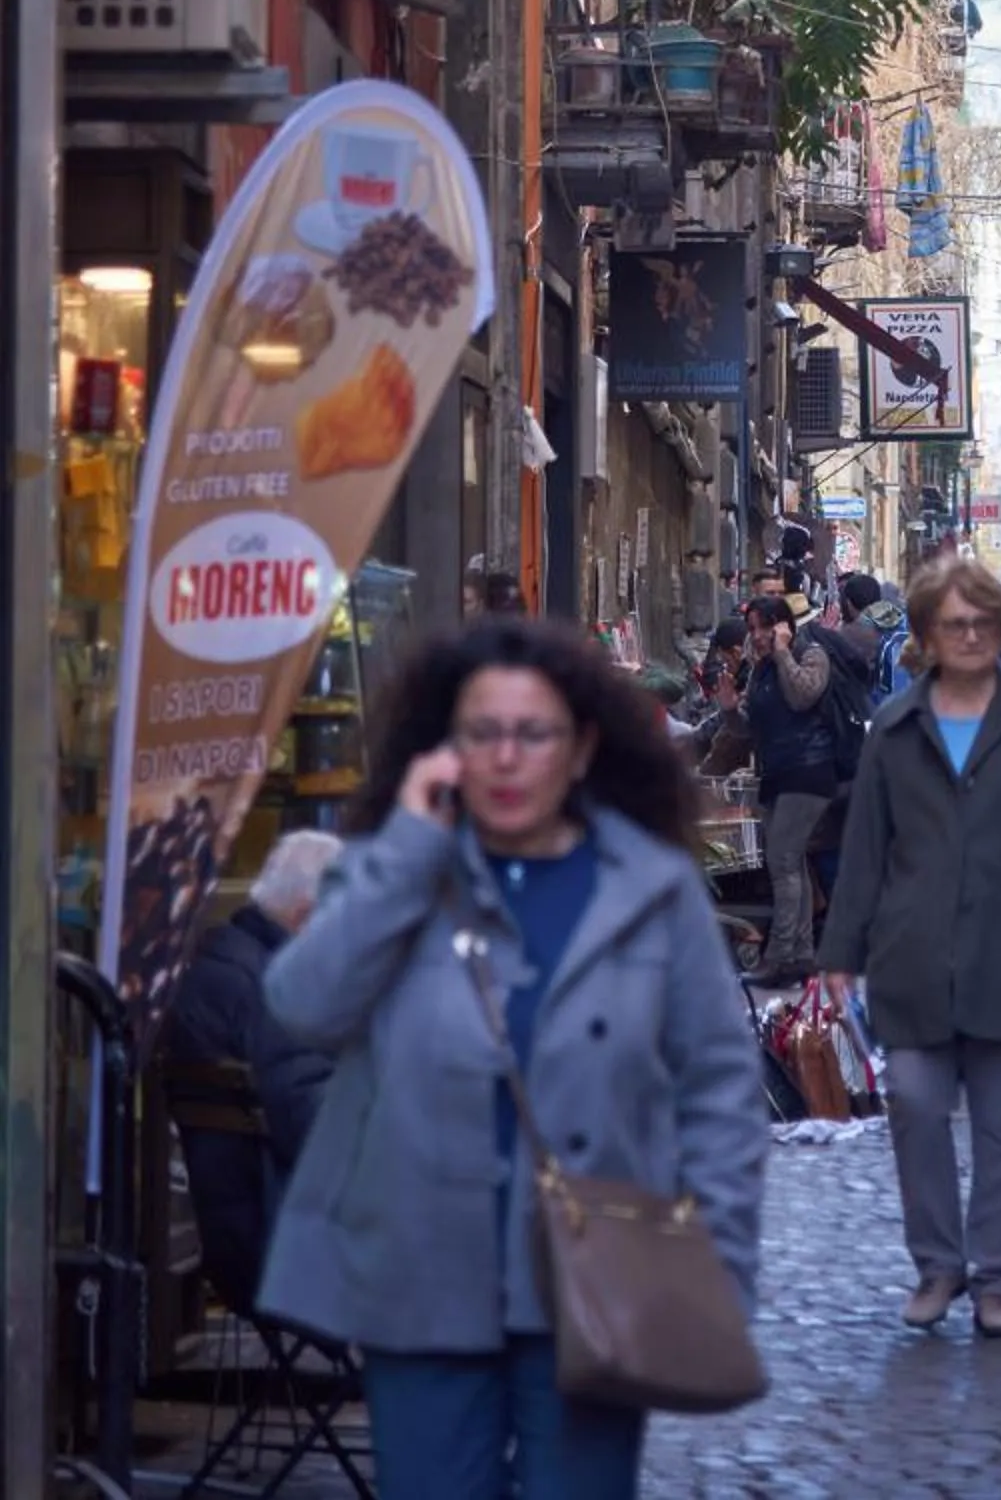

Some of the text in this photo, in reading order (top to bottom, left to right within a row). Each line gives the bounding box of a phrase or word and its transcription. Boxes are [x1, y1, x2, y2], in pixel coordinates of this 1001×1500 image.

[887, 324, 942, 334] PIZZA
[888, 311, 942, 322] VERA
[166, 471, 290, 503] GLUTEN FREE
[164, 674, 263, 722] SAPORI
[136, 747, 165, 783] DI
